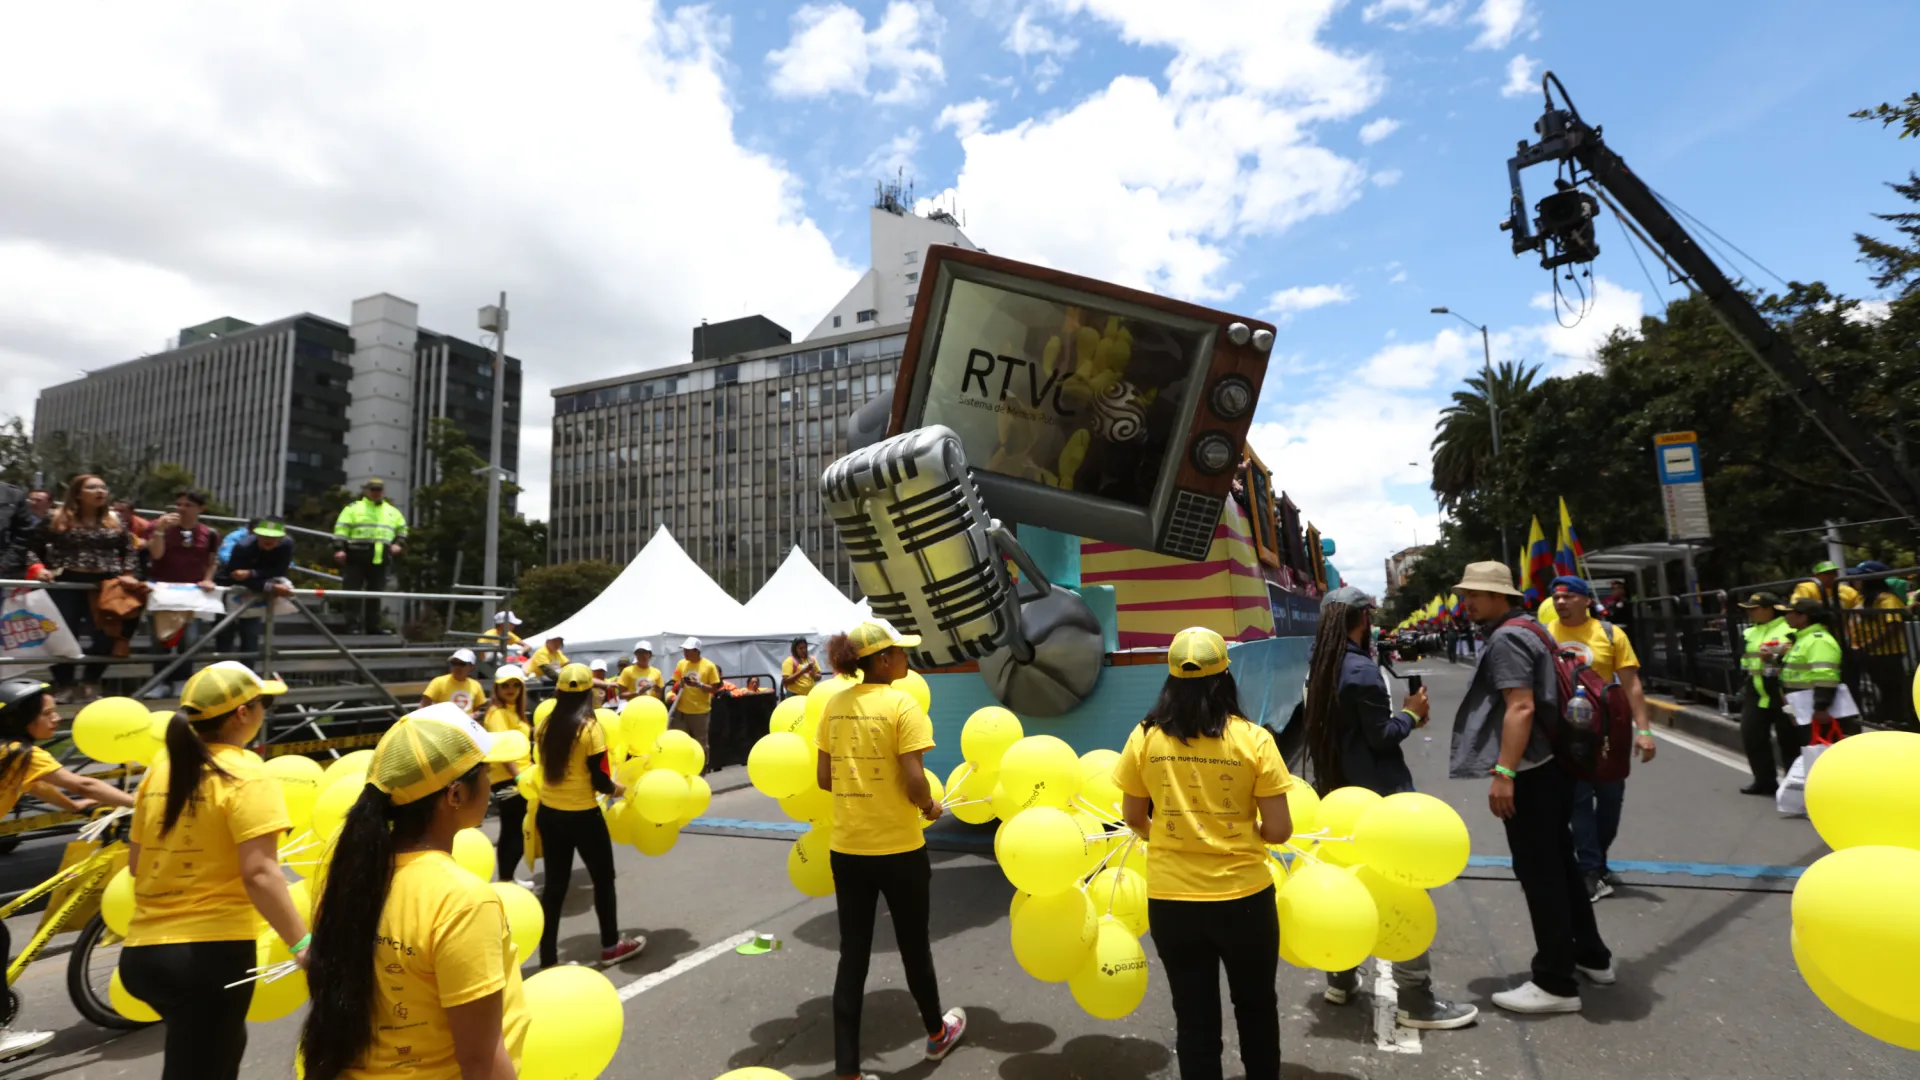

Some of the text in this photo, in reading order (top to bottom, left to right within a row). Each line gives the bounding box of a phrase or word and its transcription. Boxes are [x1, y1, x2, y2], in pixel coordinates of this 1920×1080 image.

[958, 394, 993, 412] Sistema
[1150, 755, 1176, 763] Conoce
[1209, 759, 1244, 767] servicios.
